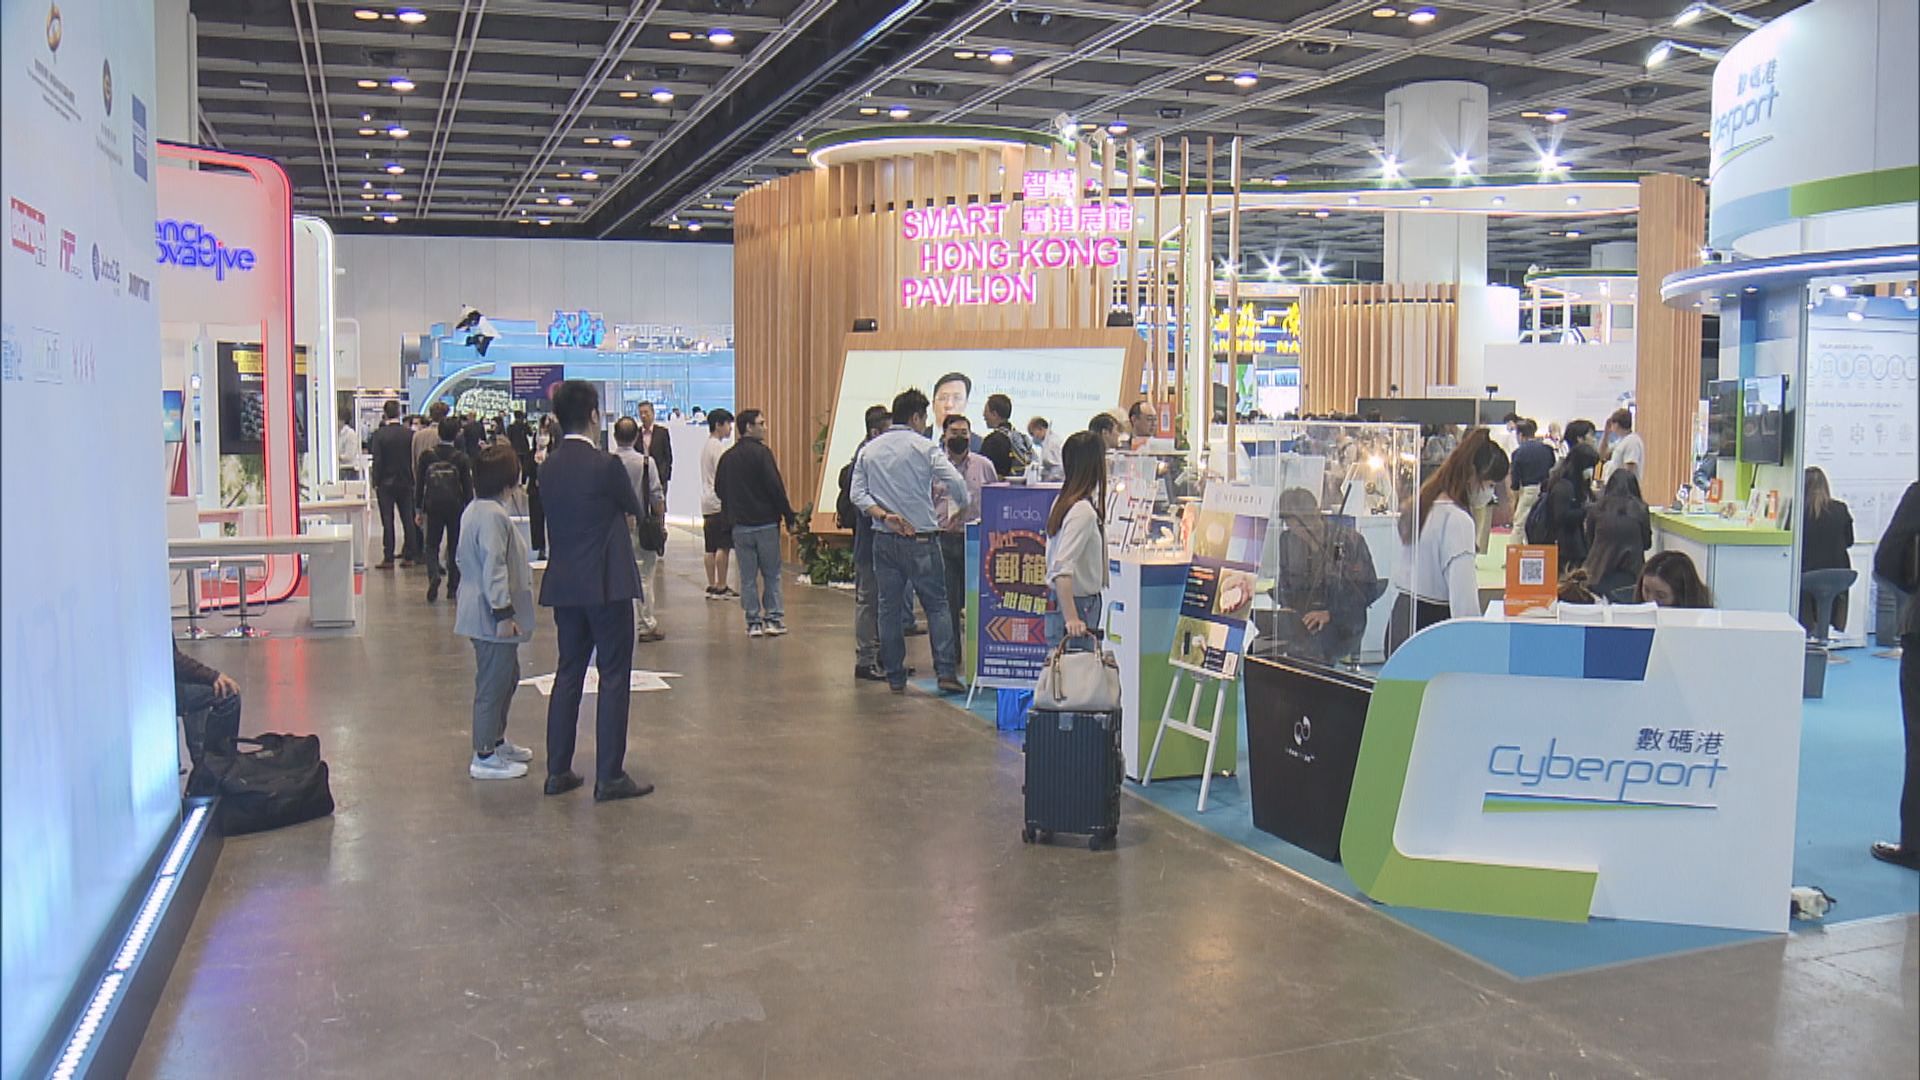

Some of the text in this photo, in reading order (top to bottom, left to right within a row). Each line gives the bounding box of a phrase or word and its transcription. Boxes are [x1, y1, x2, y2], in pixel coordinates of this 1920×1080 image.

[903, 203, 1008, 241] SMART
[921, 236, 1121, 273] HONG KONG
[902, 272, 1037, 309] PAVILION
[1635, 727, 1725, 755] 數碼港
[1488, 737, 1728, 801] Cyberport
